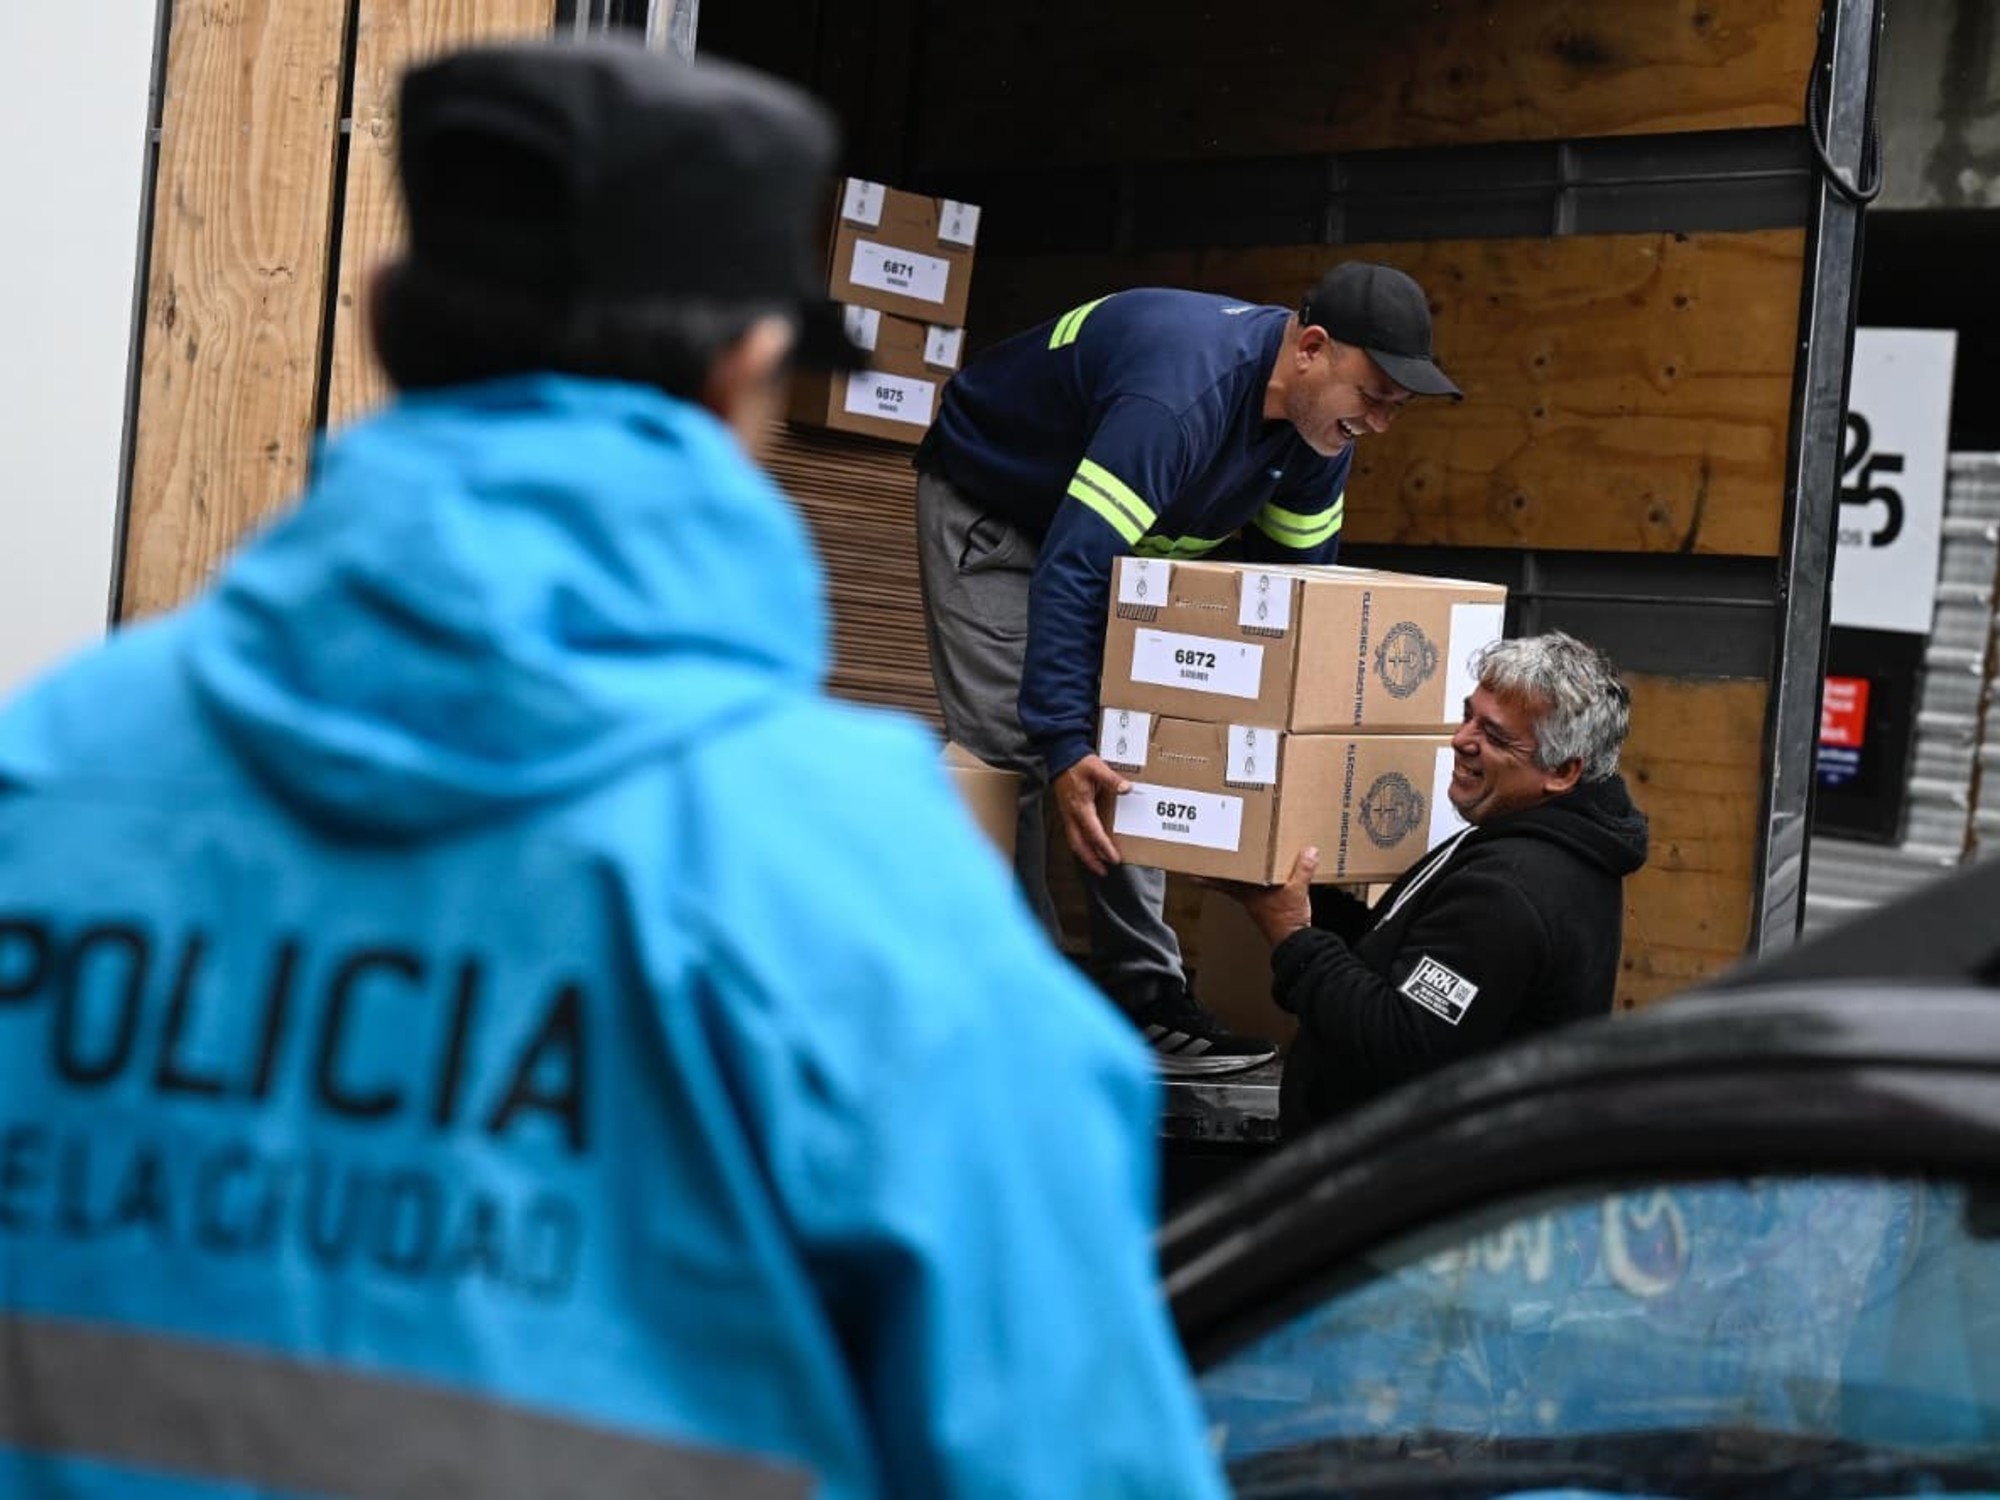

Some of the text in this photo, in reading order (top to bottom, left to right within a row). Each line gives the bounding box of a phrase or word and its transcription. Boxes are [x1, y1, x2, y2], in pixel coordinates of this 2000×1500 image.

[883, 259, 914, 279] 6871
[875, 386, 904, 403] 6875
[1839, 411, 1904, 548] 25
[1837, 529, 1863, 547] OS
[1174, 649, 1216, 669] 6872
[1344, 743, 1357, 809] ELECCIONES
[1156, 801, 1197, 821] 6876
[1414, 962, 1458, 995] HRK
[0, 915, 590, 1153] POLICIA
